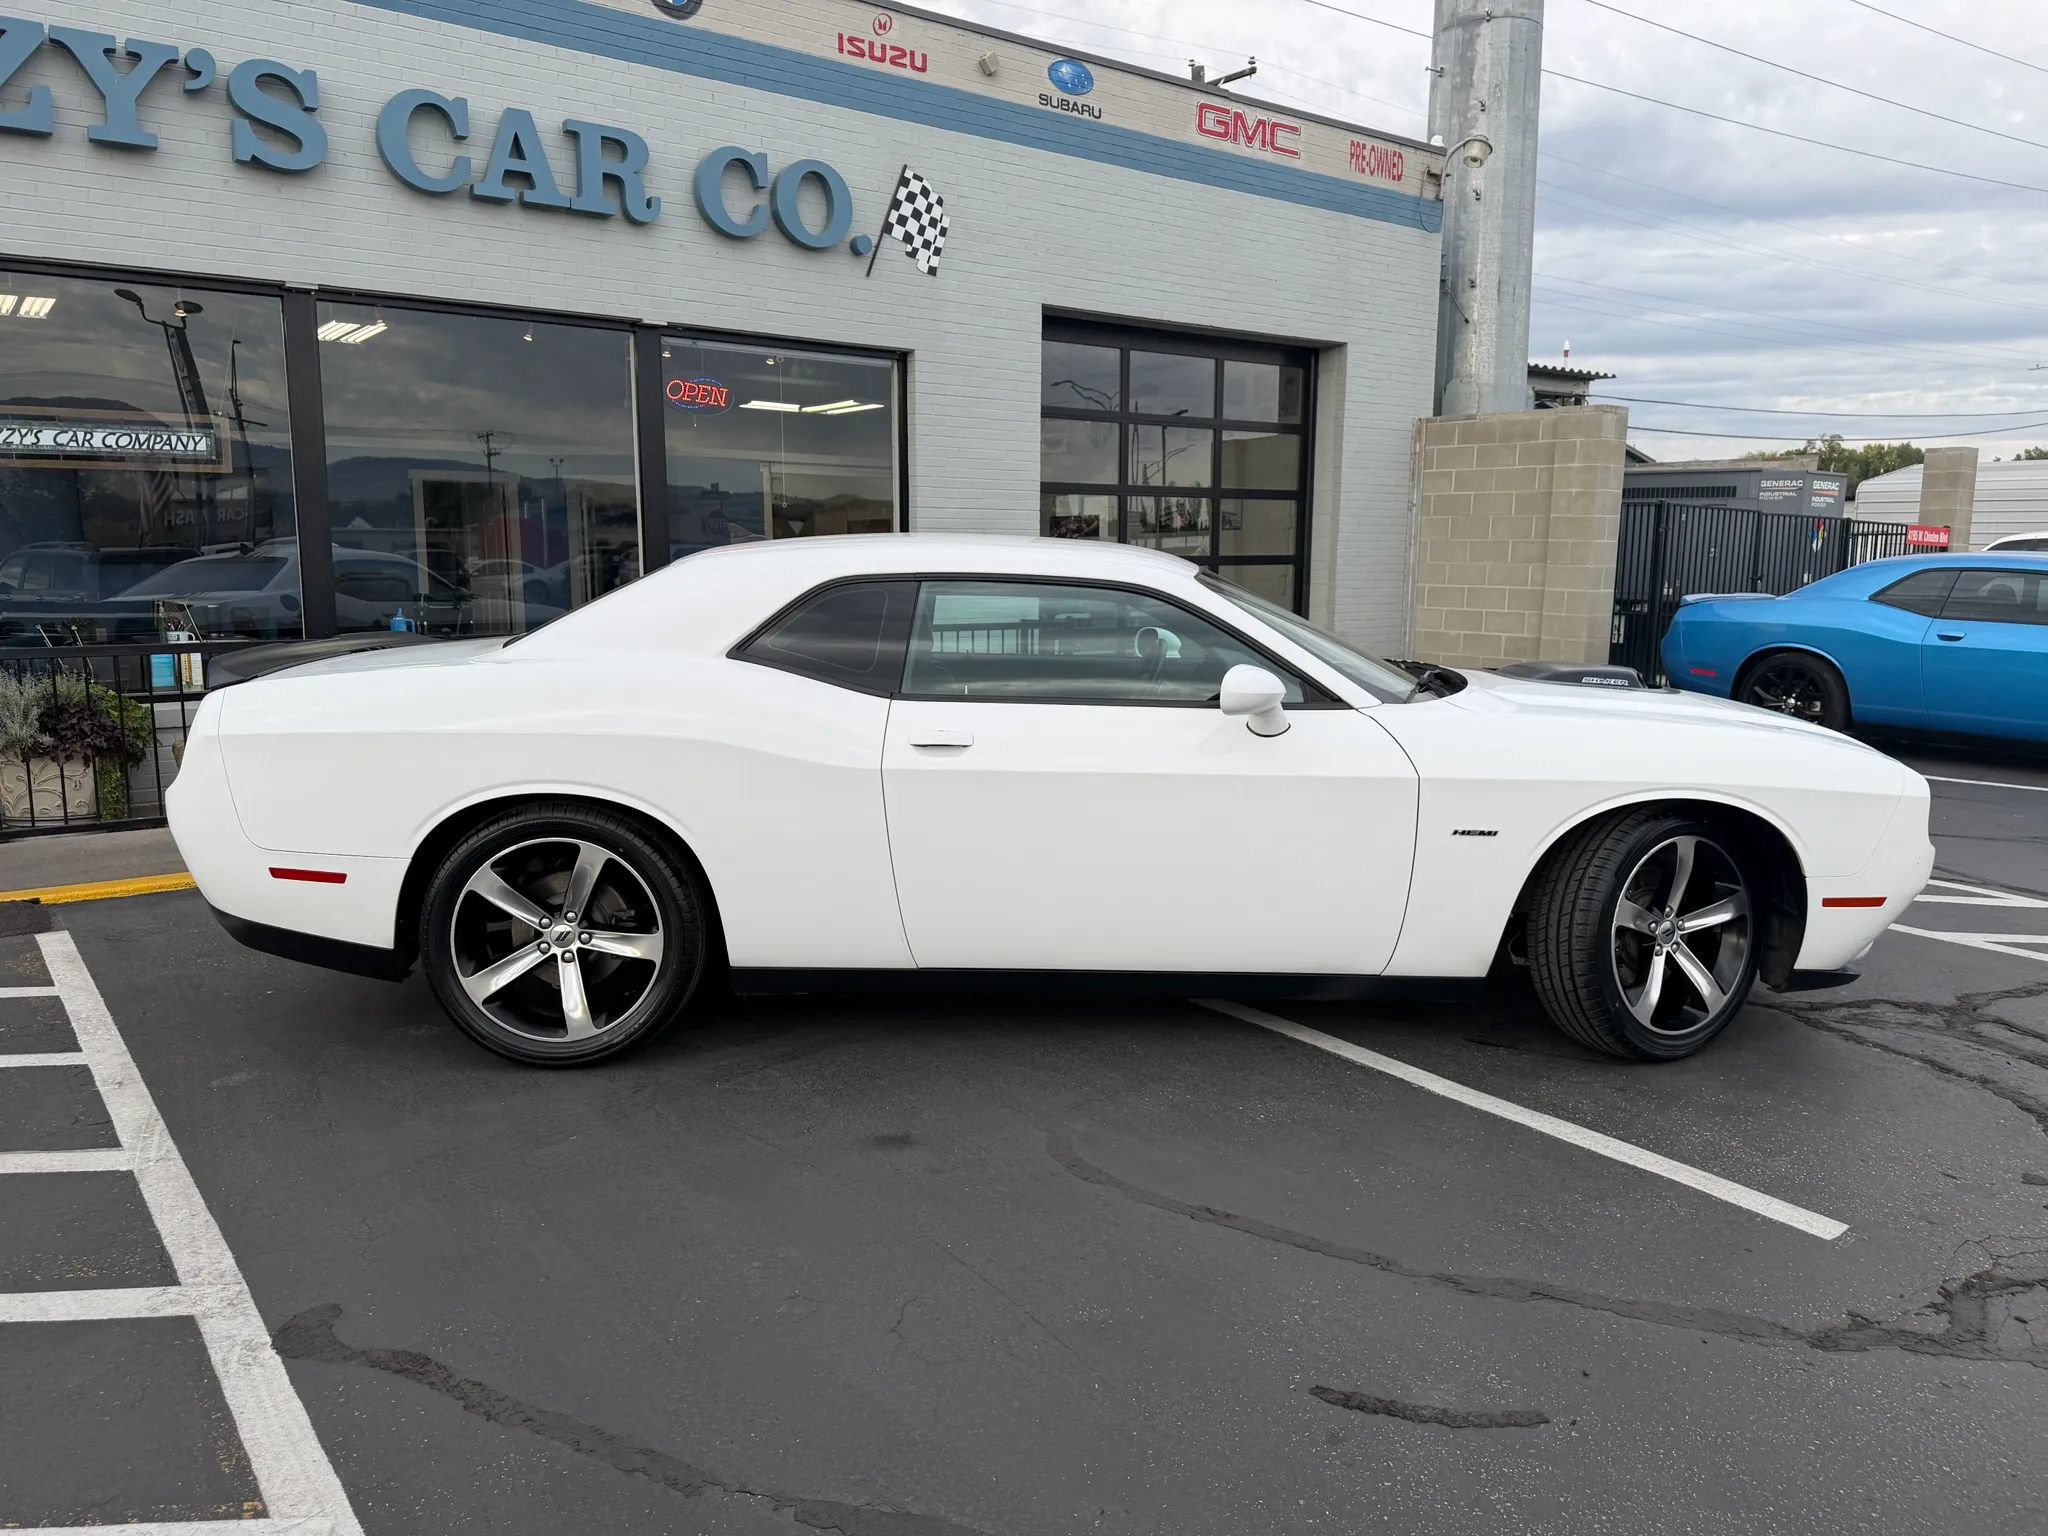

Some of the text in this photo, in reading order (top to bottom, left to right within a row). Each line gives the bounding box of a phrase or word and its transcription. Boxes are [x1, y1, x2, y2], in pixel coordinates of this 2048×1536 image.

[837, 32, 928, 73] ISUZU
[1038, 92, 1102, 120] SUBARU
[1195, 100, 1301, 158] GMC
[376, 88, 661, 225] CAR
[694, 145, 873, 256] CO.
[1349, 138, 1404, 182] PRE-OWNED
[666, 379, 728, 407] OPEN
[0, 427, 205, 452] ZY'S CAR COMPANY
[1812, 480, 1840, 490] GENERAC
[1581, 676, 1629, 687] SHAKER
[1451, 829, 1498, 837] HEMI
